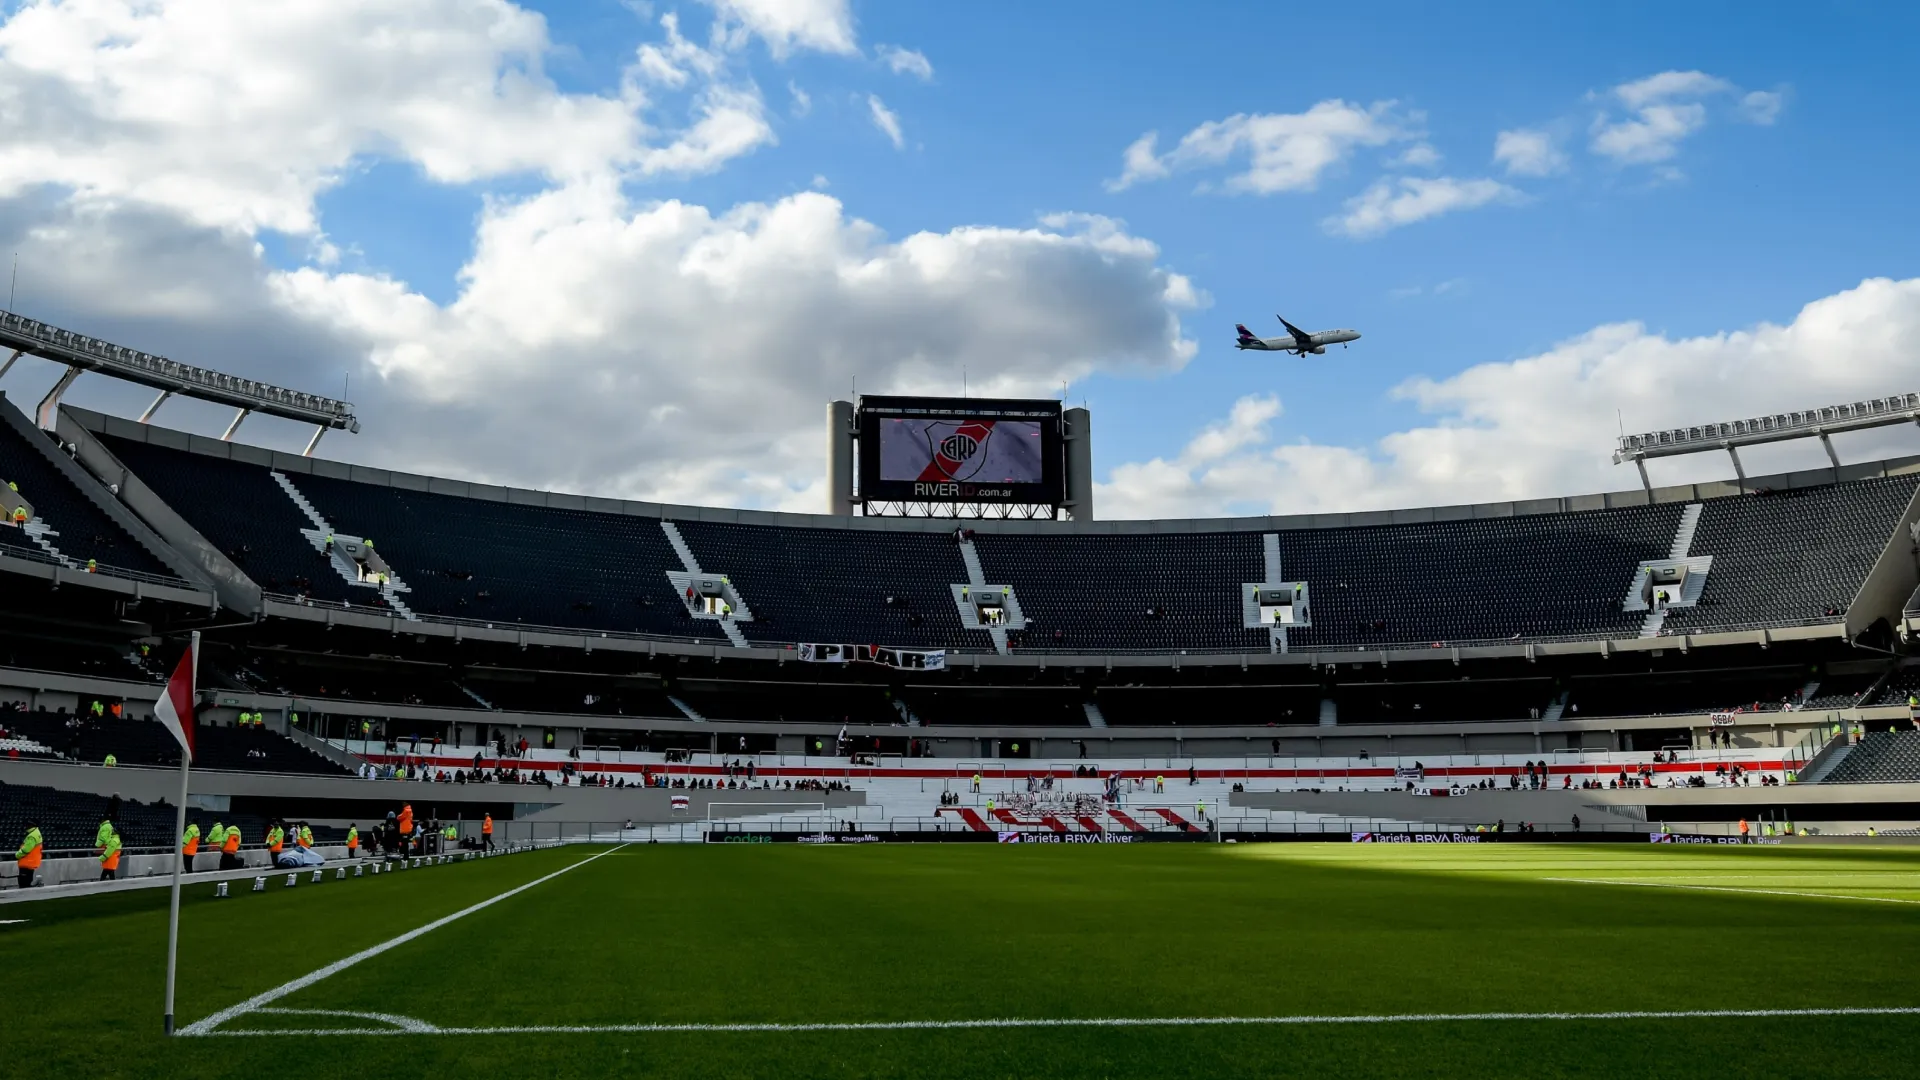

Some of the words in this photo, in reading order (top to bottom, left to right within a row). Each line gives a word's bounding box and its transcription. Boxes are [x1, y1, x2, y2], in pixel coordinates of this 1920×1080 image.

[940, 434, 978, 460] CARP
[815, 643, 926, 670] PILAR
[724, 832, 772, 843] codere
[1105, 832, 1133, 843] River
[1452, 833, 1481, 843] River
